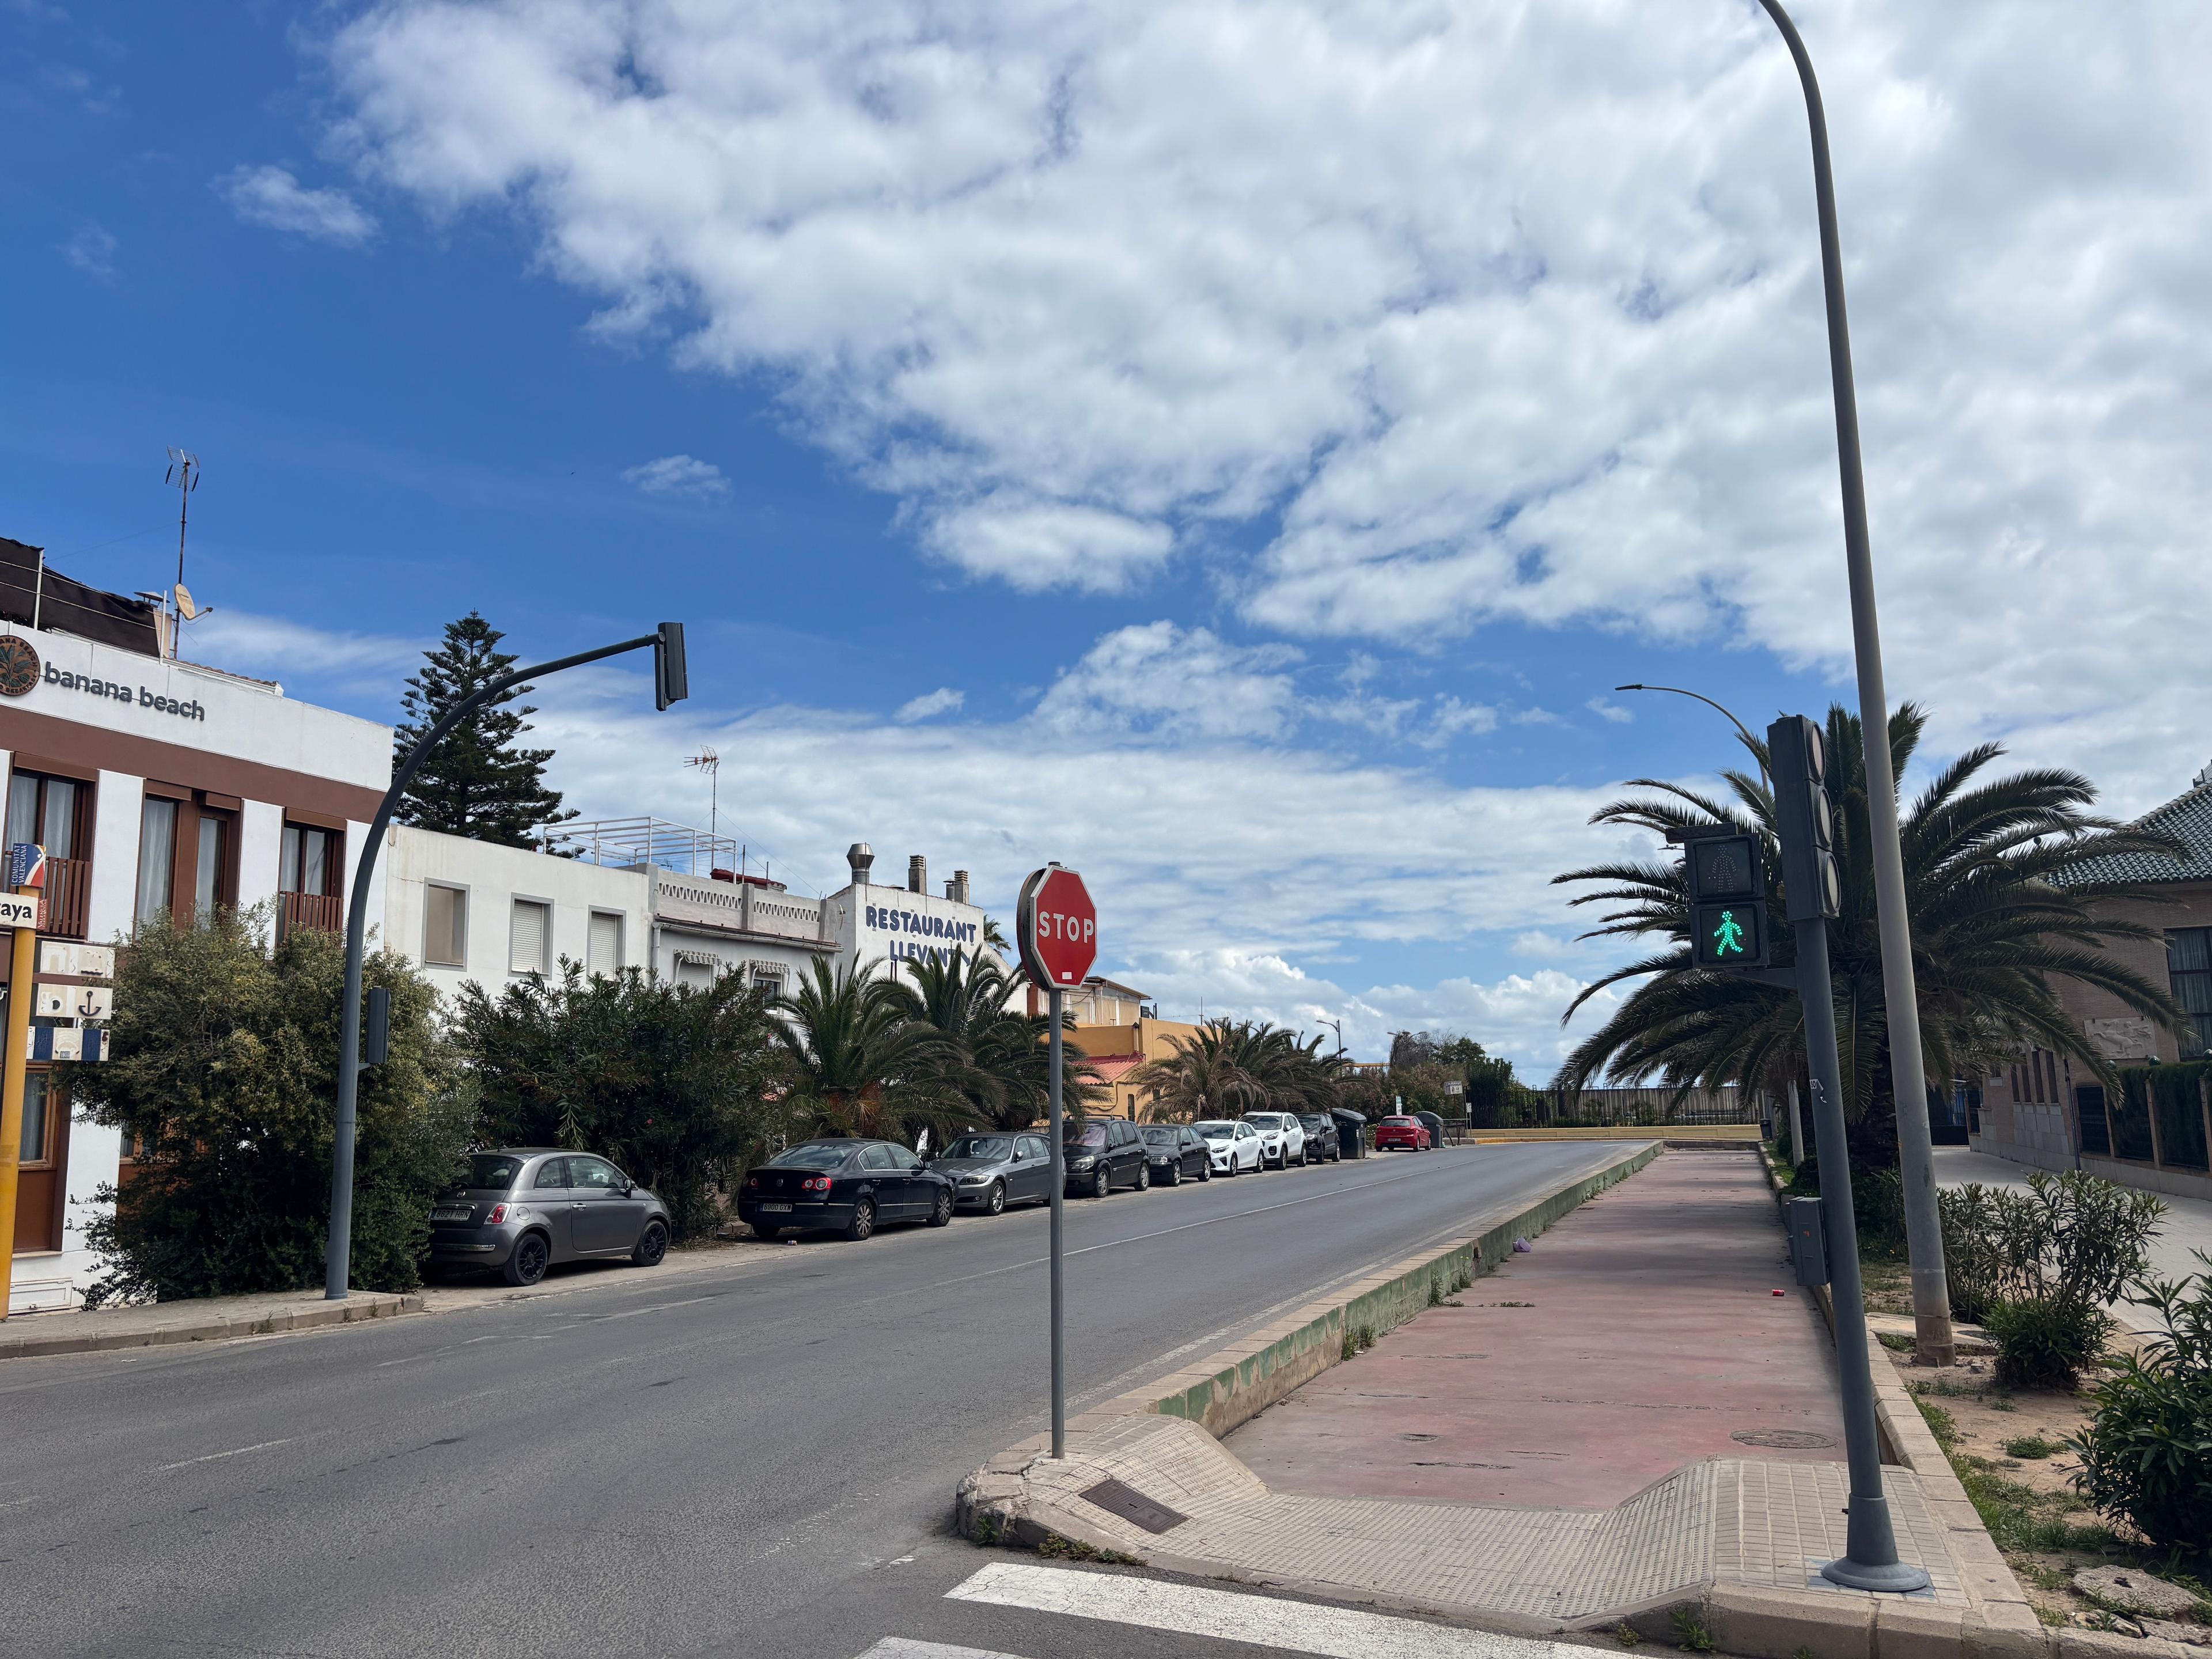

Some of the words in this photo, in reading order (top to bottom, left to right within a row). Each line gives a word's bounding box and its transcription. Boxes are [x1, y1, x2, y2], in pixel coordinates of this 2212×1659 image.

[45, 661, 132, 702] banana
[139, 685, 205, 722] beach
[12, 844, 21, 883] COMUNITAT
[18, 844, 28, 884] VALENCIANA
[0, 903, 32, 922] aya
[866, 906, 976, 943] RESTAURANT
[1039, 911, 1094, 944] STOP
